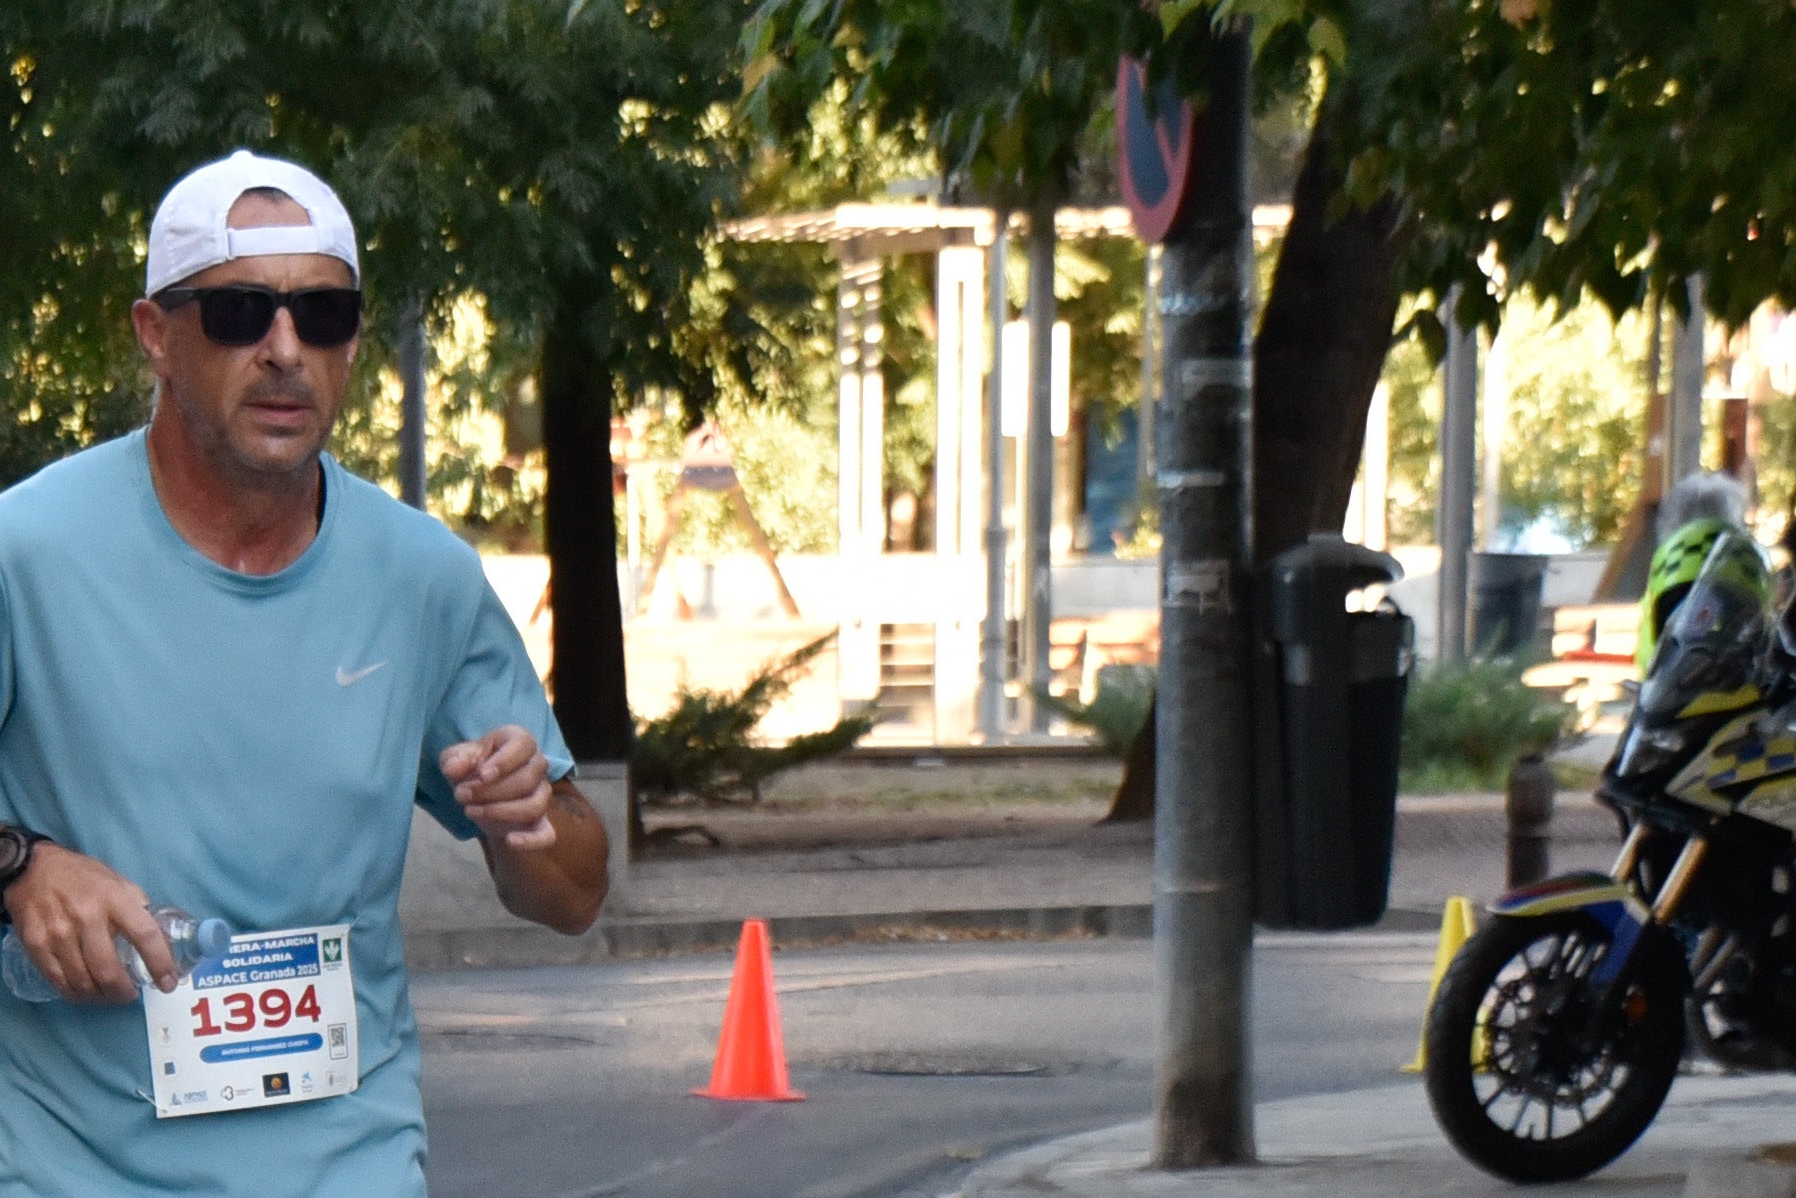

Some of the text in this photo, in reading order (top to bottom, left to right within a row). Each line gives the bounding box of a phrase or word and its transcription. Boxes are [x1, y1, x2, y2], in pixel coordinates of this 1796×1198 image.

[222, 952, 294, 968] SOLIDARIA
[198, 972, 247, 987] ASPACE
[250, 966, 297, 981] Granada
[190, 984, 321, 1037] 1394
